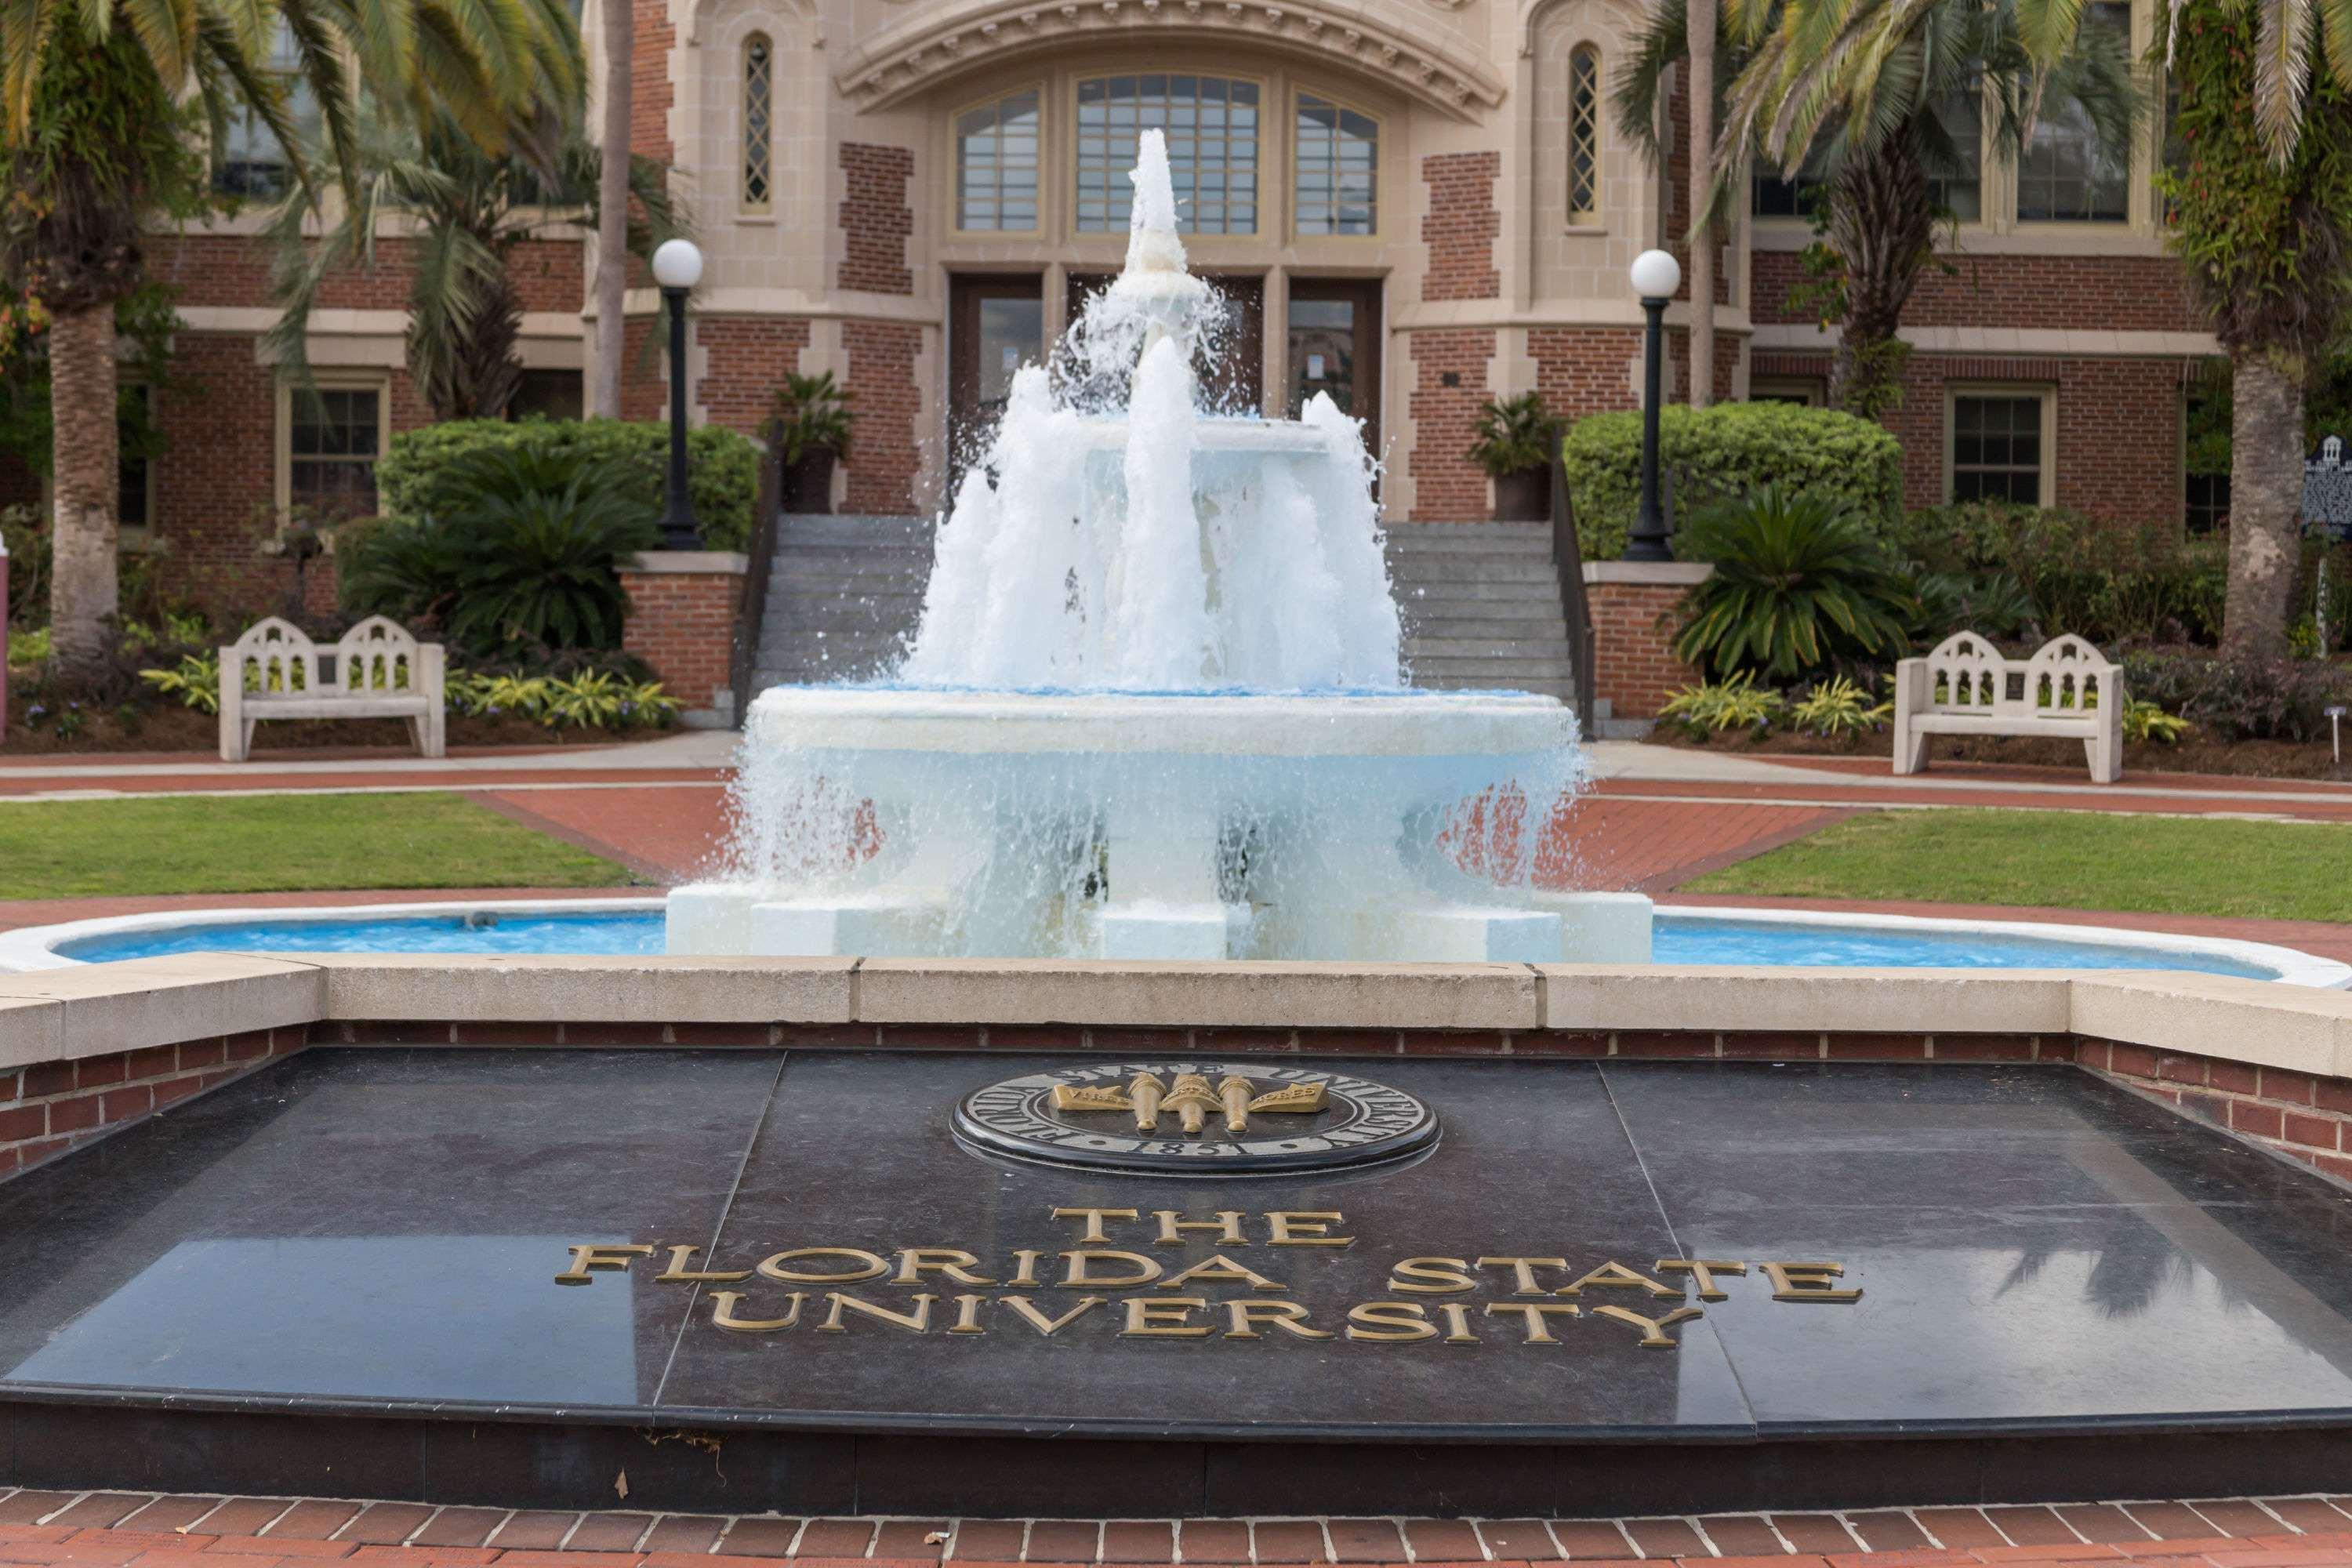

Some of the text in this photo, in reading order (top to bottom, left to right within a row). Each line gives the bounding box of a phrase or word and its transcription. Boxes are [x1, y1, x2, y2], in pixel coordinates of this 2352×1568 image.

[972, 1086, 1085, 1143] FLORIDA
[1269, 1069, 1418, 1148] UNIVERSITY
[1127, 1142, 1254, 1156] 1851
[1053, 1207, 1356, 1248] THE
[554, 1244, 1863, 1302] FLORIDA STATE
[709, 1292, 1704, 1347] UNIVERSITY
